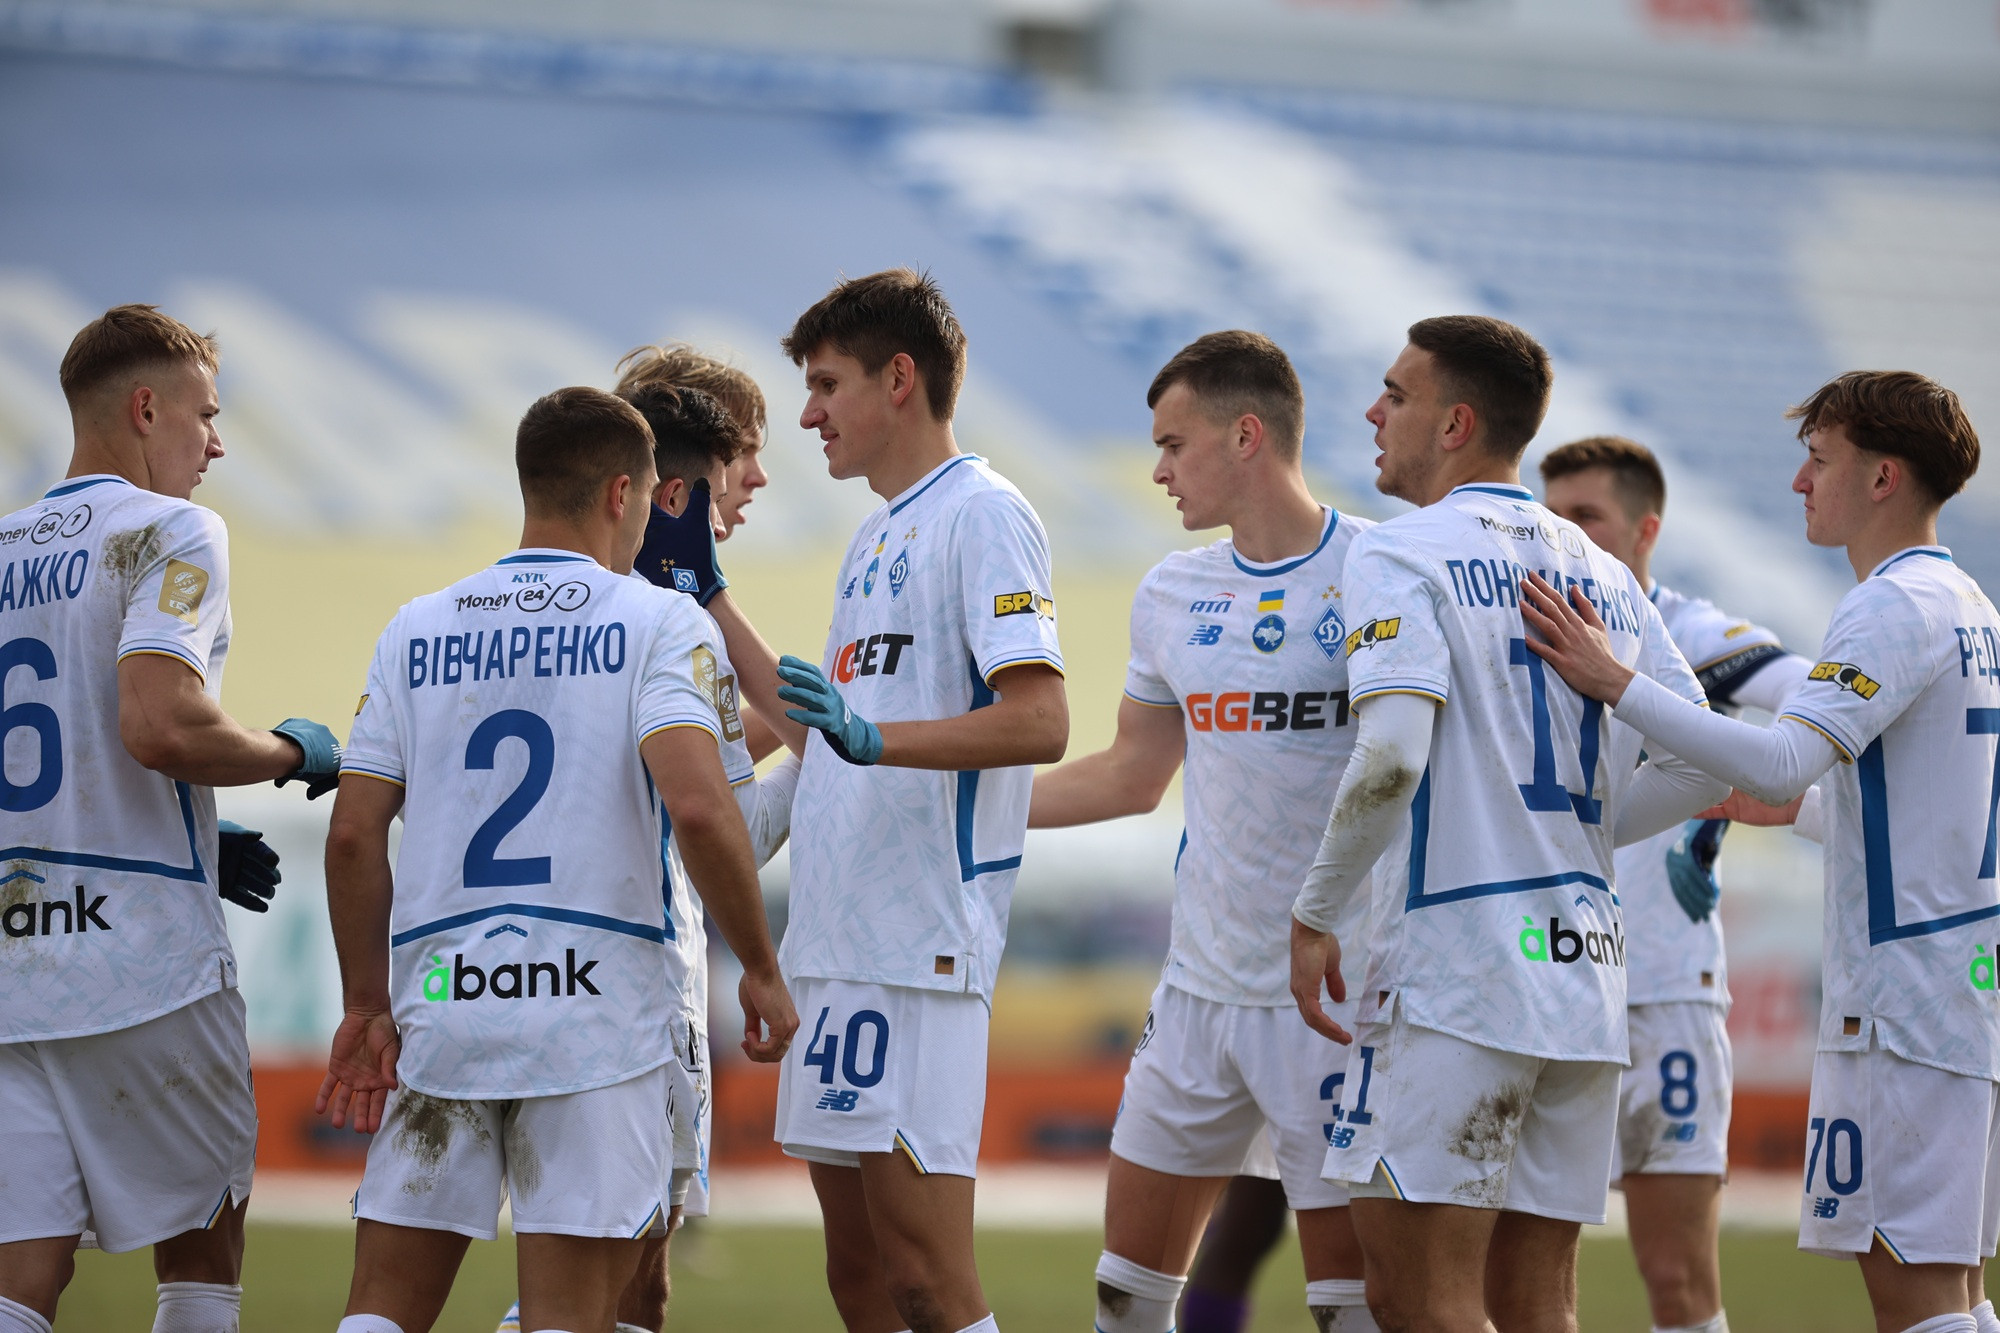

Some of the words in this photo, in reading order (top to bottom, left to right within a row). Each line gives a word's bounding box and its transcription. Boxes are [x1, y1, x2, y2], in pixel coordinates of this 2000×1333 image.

[0, 526, 32, 542] ney
[37, 521, 57, 535] 24
[1475, 516, 1535, 541] Money
[454, 592, 514, 612] Money
[523, 589, 545, 602] 24
[566, 588, 578, 600] 7
[511, 572, 549, 584] KYIV
[408, 621, 627, 690] ВІВЧАРЕНКО
[1954, 626, 2000, 686] РЕД
[0, 637, 64, 813] 6
[1508, 637, 1603, 827] 11
[462, 708, 556, 889] 2
[803, 1006, 890, 1089] 40
[1660, 1050, 1699, 1118] 8
[1805, 1117, 1863, 1196] 70
